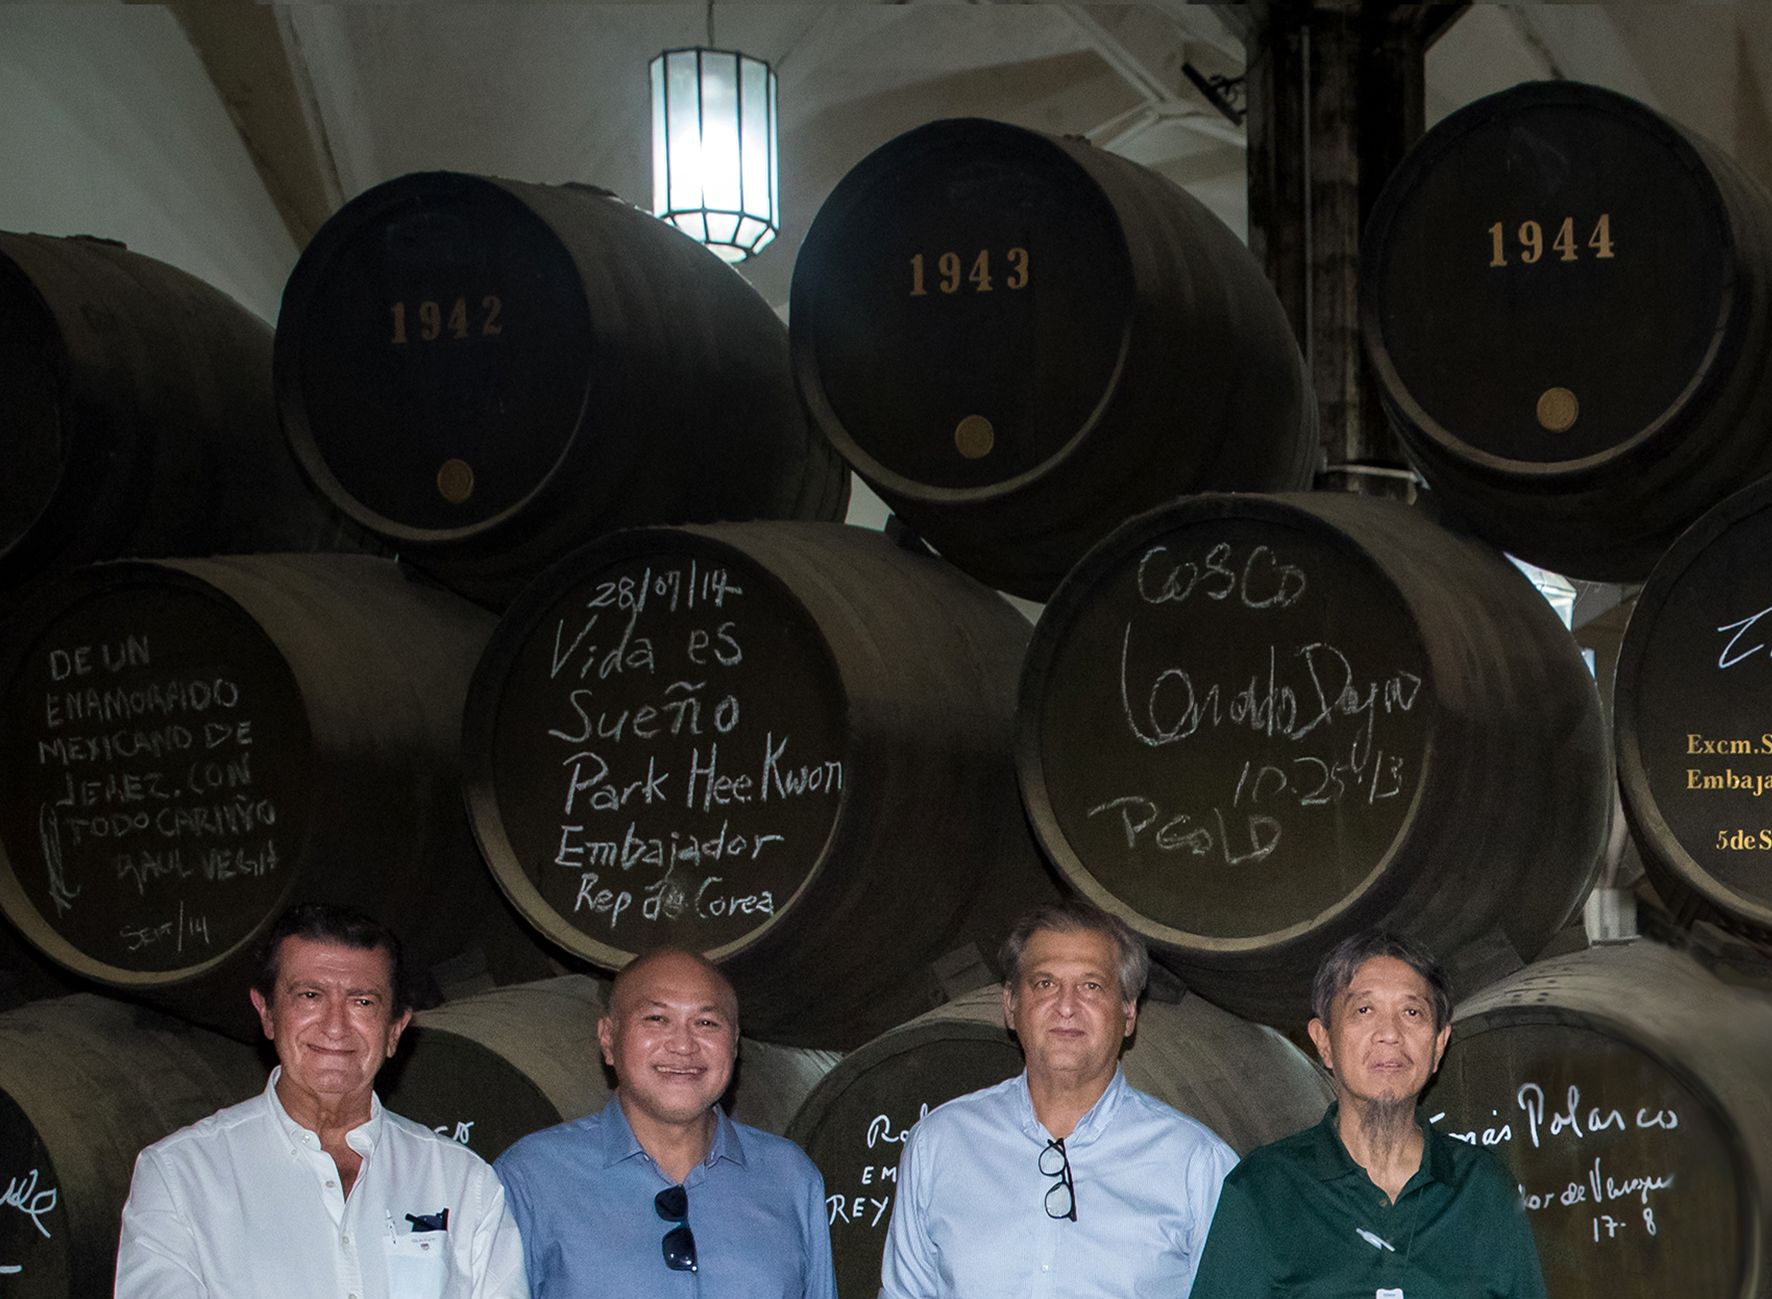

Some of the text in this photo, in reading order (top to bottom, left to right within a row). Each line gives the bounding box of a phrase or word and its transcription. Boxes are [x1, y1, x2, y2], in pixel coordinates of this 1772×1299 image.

[1488, 213, 1615, 267] 1944
[909, 247, 1031, 296] 1943
[390, 295, 503, 344] 1942
[50, 634, 150, 681] DE UN
[550, 602, 655, 680] Vida
[204, 721, 253, 749] DE
[548, 680, 740, 744] Sueño
[563, 730, 844, 816] Park Hee Kwon
[554, 819, 785, 880] Embajador
[573, 872, 633, 929] Rep
[696, 876, 774, 919] Corea
[1518, 1082, 1678, 1148] Polanco
